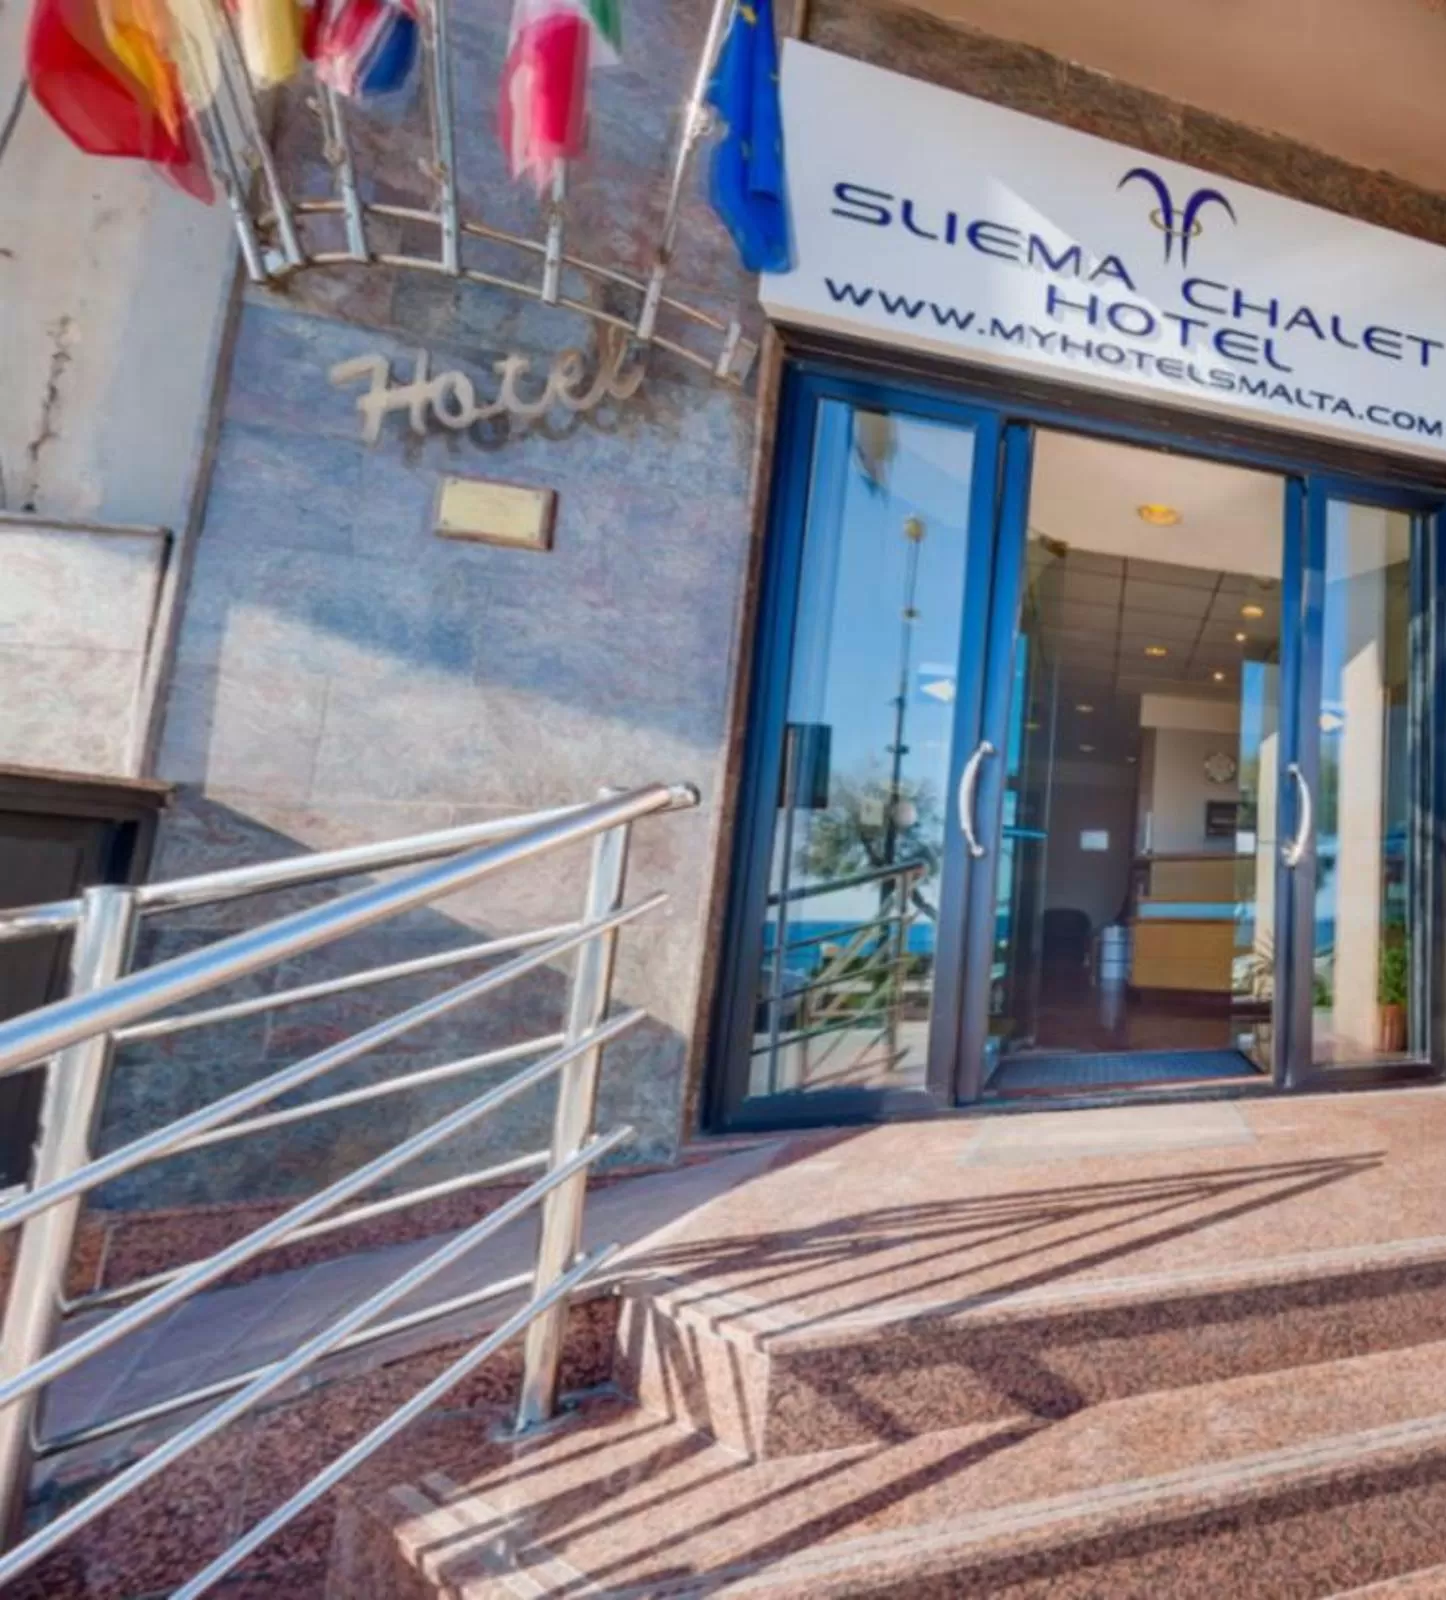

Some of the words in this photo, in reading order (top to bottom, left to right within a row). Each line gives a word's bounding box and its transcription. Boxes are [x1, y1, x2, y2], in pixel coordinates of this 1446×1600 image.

[831, 181, 1136, 291] SLIEMA
[1181, 277, 1446, 367] CHALET
[1045, 284, 1293, 372] HOTEL
[331, 325, 645, 445] Hotel
[824, 277, 1444, 437] WWW.MYHOTELSMALTA.COM
